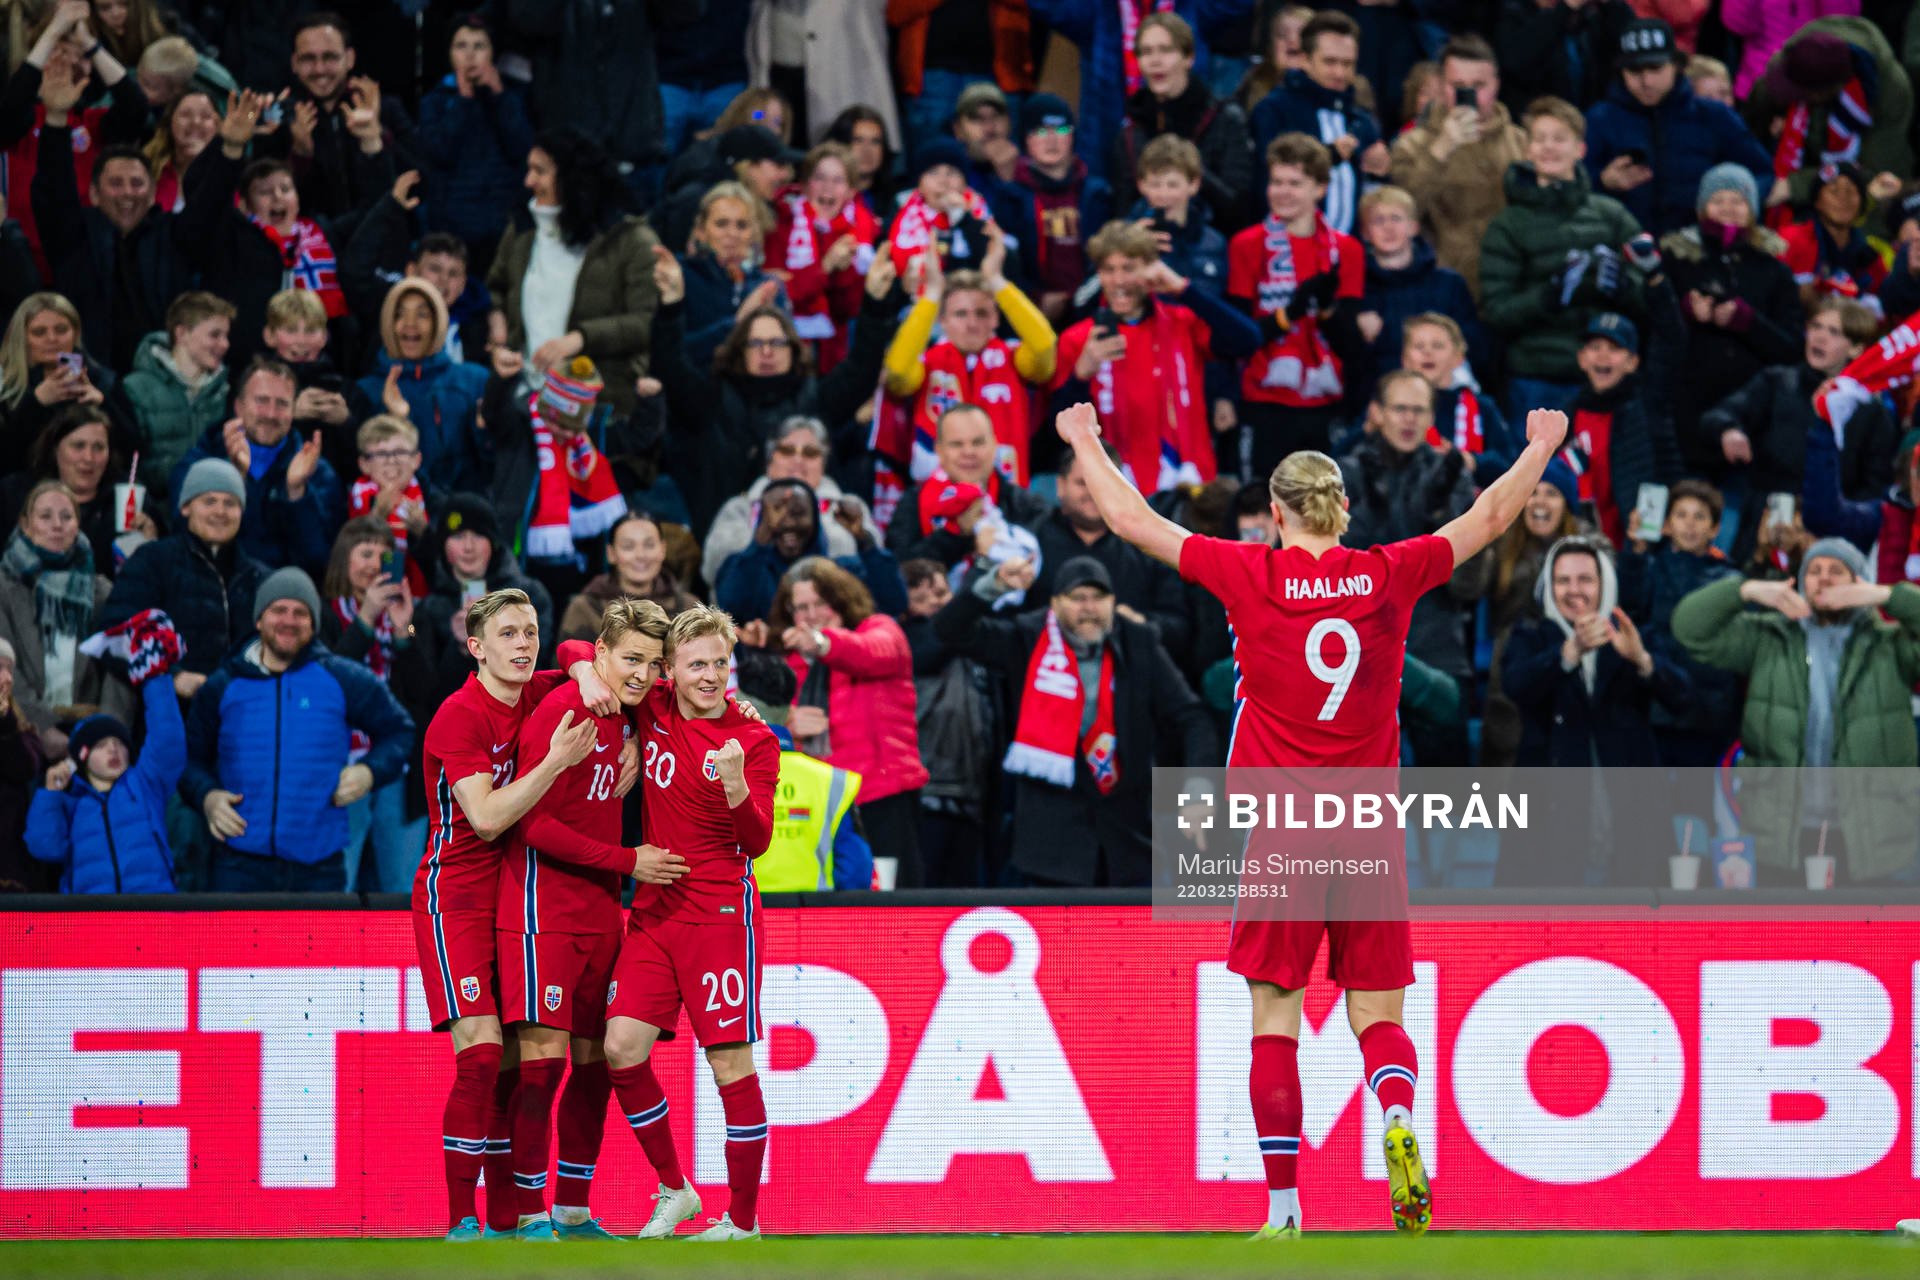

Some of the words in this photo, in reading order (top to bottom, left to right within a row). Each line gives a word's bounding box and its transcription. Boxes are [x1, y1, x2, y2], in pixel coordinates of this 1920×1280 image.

[1284, 574, 1373, 600] HAALAND
[1304, 617, 1362, 721] 9
[586, 763, 615, 801] 10
[645, 740, 676, 790] 20
[701, 967, 745, 1012] 20
[693, 906, 1116, 1186] PÅ
[1195, 955, 1920, 1185] MOB
